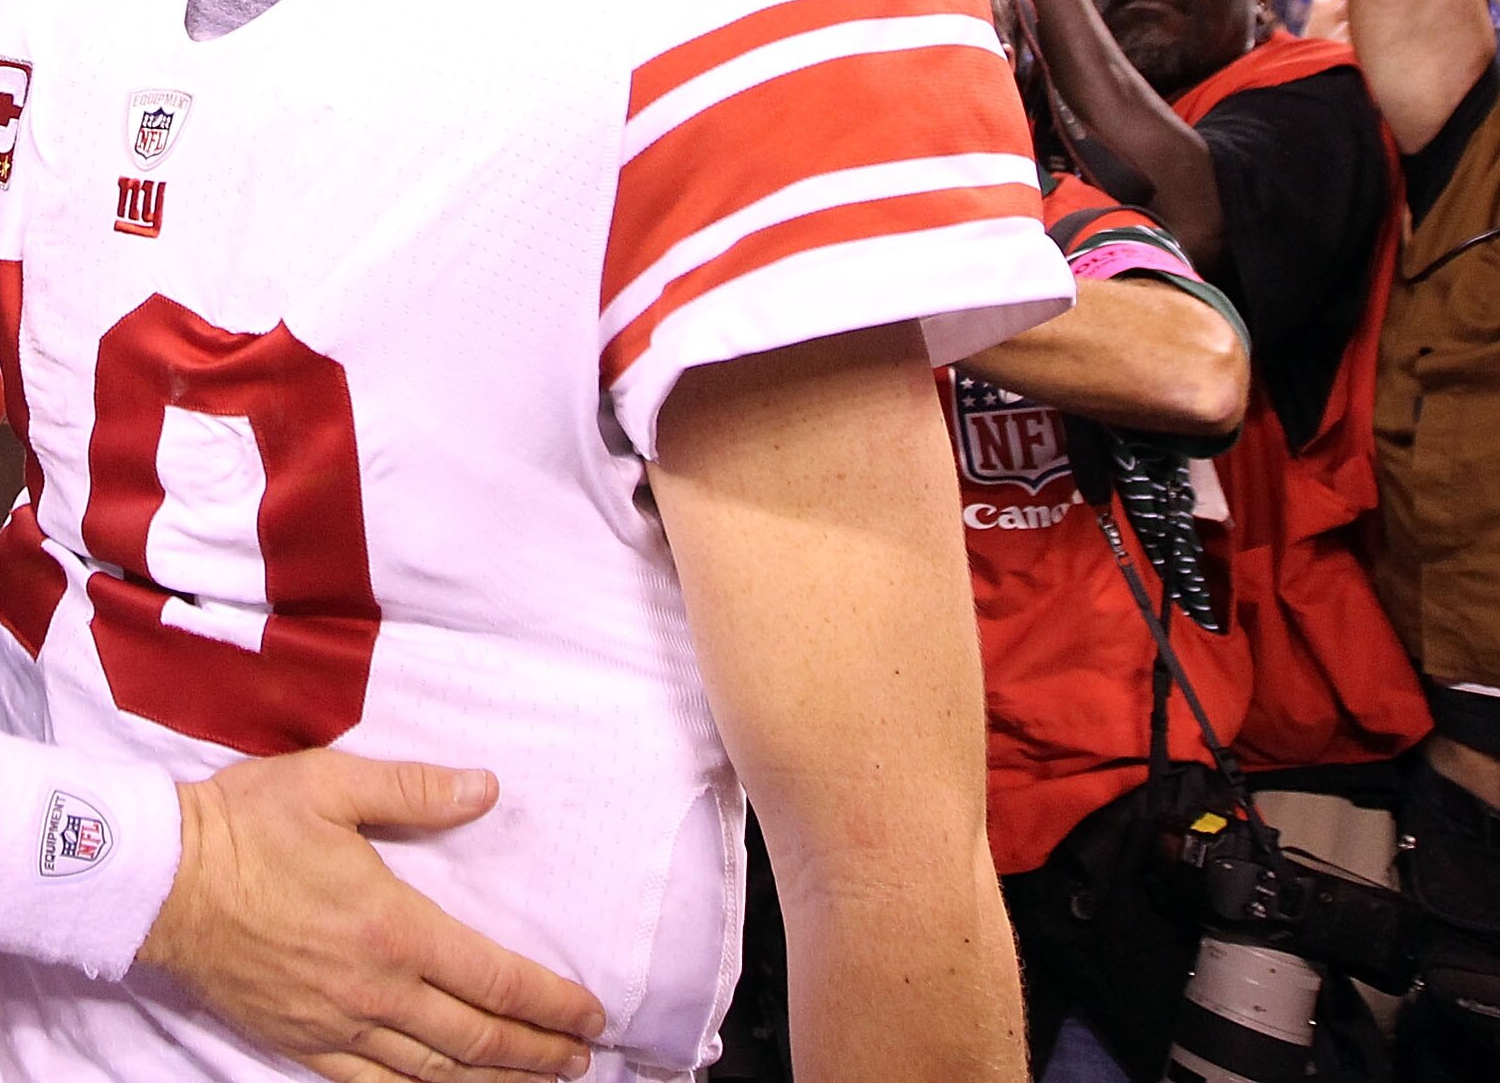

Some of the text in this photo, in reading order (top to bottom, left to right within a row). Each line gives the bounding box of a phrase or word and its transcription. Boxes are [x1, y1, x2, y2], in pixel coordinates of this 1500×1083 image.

[132, 93, 189, 110] EQUIPMENT
[135, 127, 168, 157] NFL
[44, 795, 66, 871] EQUIPMENT
[77, 822, 102, 859] NFL
